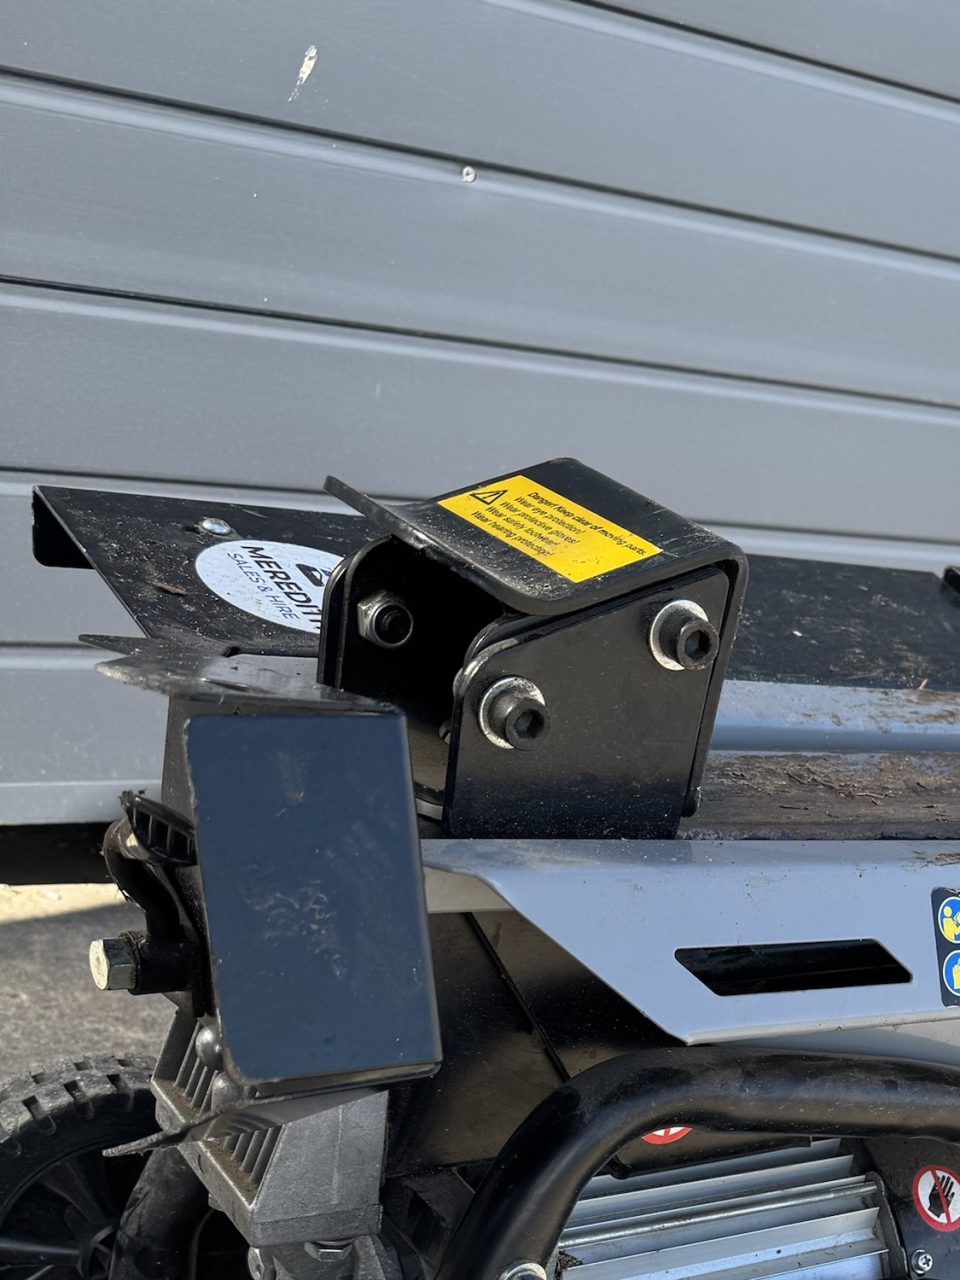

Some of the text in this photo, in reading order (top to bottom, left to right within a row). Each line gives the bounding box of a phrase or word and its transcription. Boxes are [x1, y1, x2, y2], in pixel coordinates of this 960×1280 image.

[500, 501, 521, 513] Wear
[514, 512, 553, 531] protective
[514, 497, 535, 508] Wear
[471, 511, 491, 522] Wear
[488, 522, 517, 538] hearing
[485, 506, 506, 518] Wear
[503, 517, 527, 530] safety
[527, 492, 559, 508] Danger!
[554, 506, 574, 517] Keep
[572, 516, 592, 526] clear
[597, 529, 627, 545] moving
[227, 552, 300, 621] SALES & HIRE
